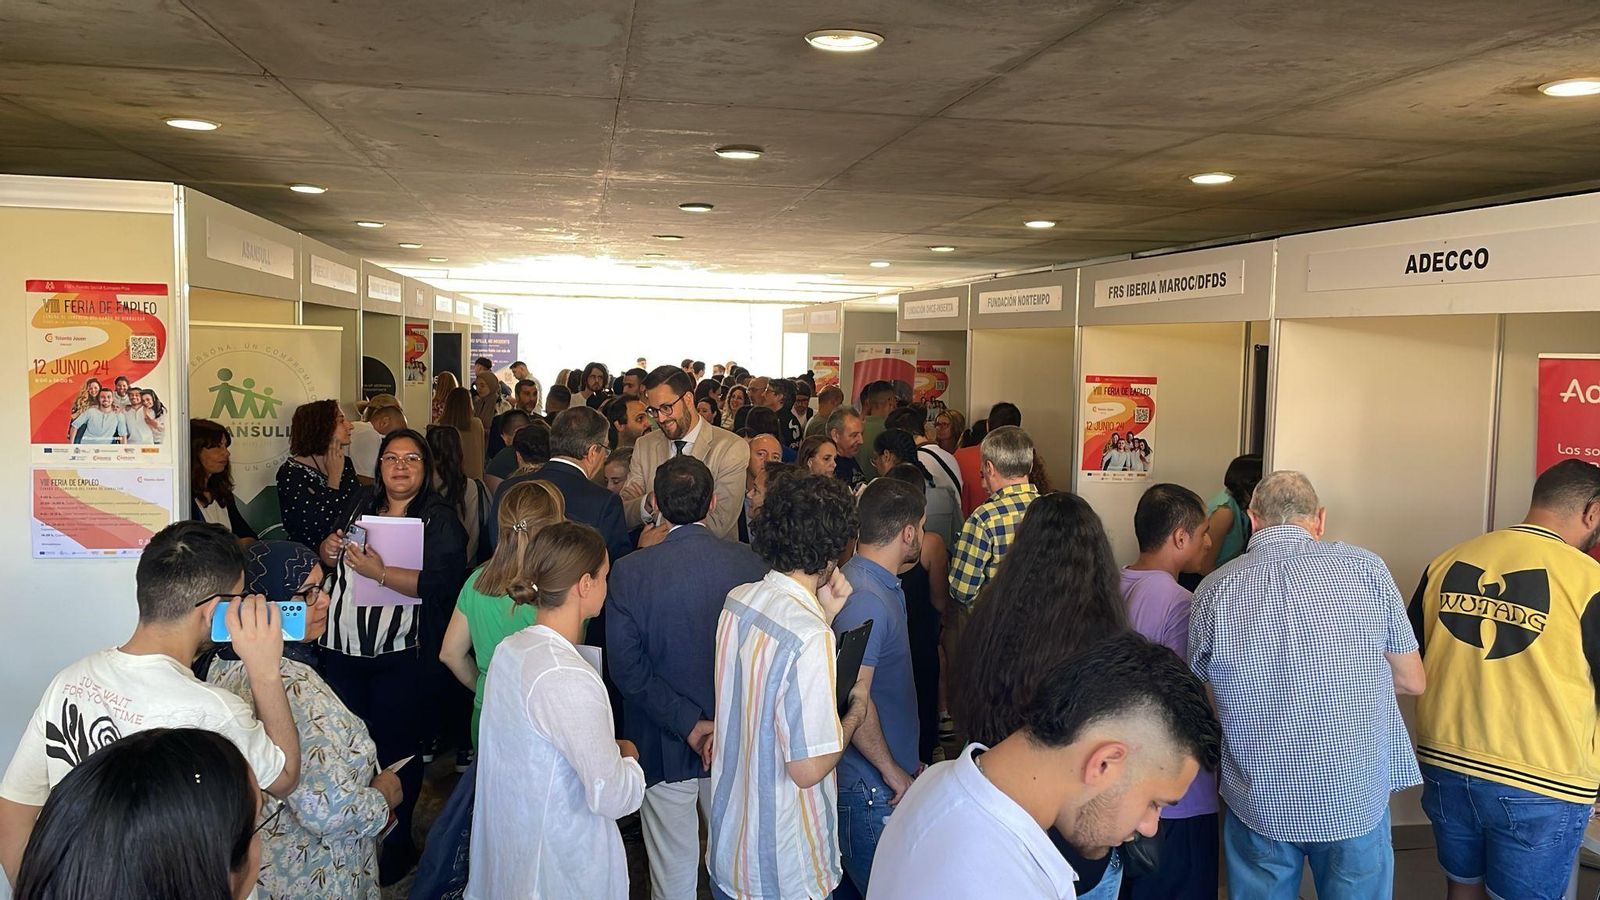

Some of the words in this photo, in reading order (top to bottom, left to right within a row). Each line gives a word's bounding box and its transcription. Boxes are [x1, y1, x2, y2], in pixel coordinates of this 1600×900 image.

[1405, 247, 1489, 274] ADECCO
[1108, 285, 1124, 299] FRS
[1126, 281, 1156, 297] IBERIA
[1159, 272, 1226, 293] MAROC/DFDS
[1017, 293, 1050, 306] NORTEMPO
[64, 299, 96, 313] FERIA
[99, 301, 113, 314] DE
[116, 301, 157, 315] EMPLEO
[33, 359, 47, 375] 12
[51, 359, 89, 375] JUNIO
[93, 360, 109, 375] 24
[1104, 386, 1120, 396] FERIA
[225, 425, 292, 438] ANSULL
[1086, 421, 1093, 431] 12
[1094, 421, 1115, 431] JUNIO
[1557, 443, 1581, 455] Las
[51, 479, 67, 487] FERIA
[69, 479, 77, 487] DE
[62, 684, 83, 698] FOR
[113, 707, 145, 725] TIME
[104, 689, 133, 708] WAIT
